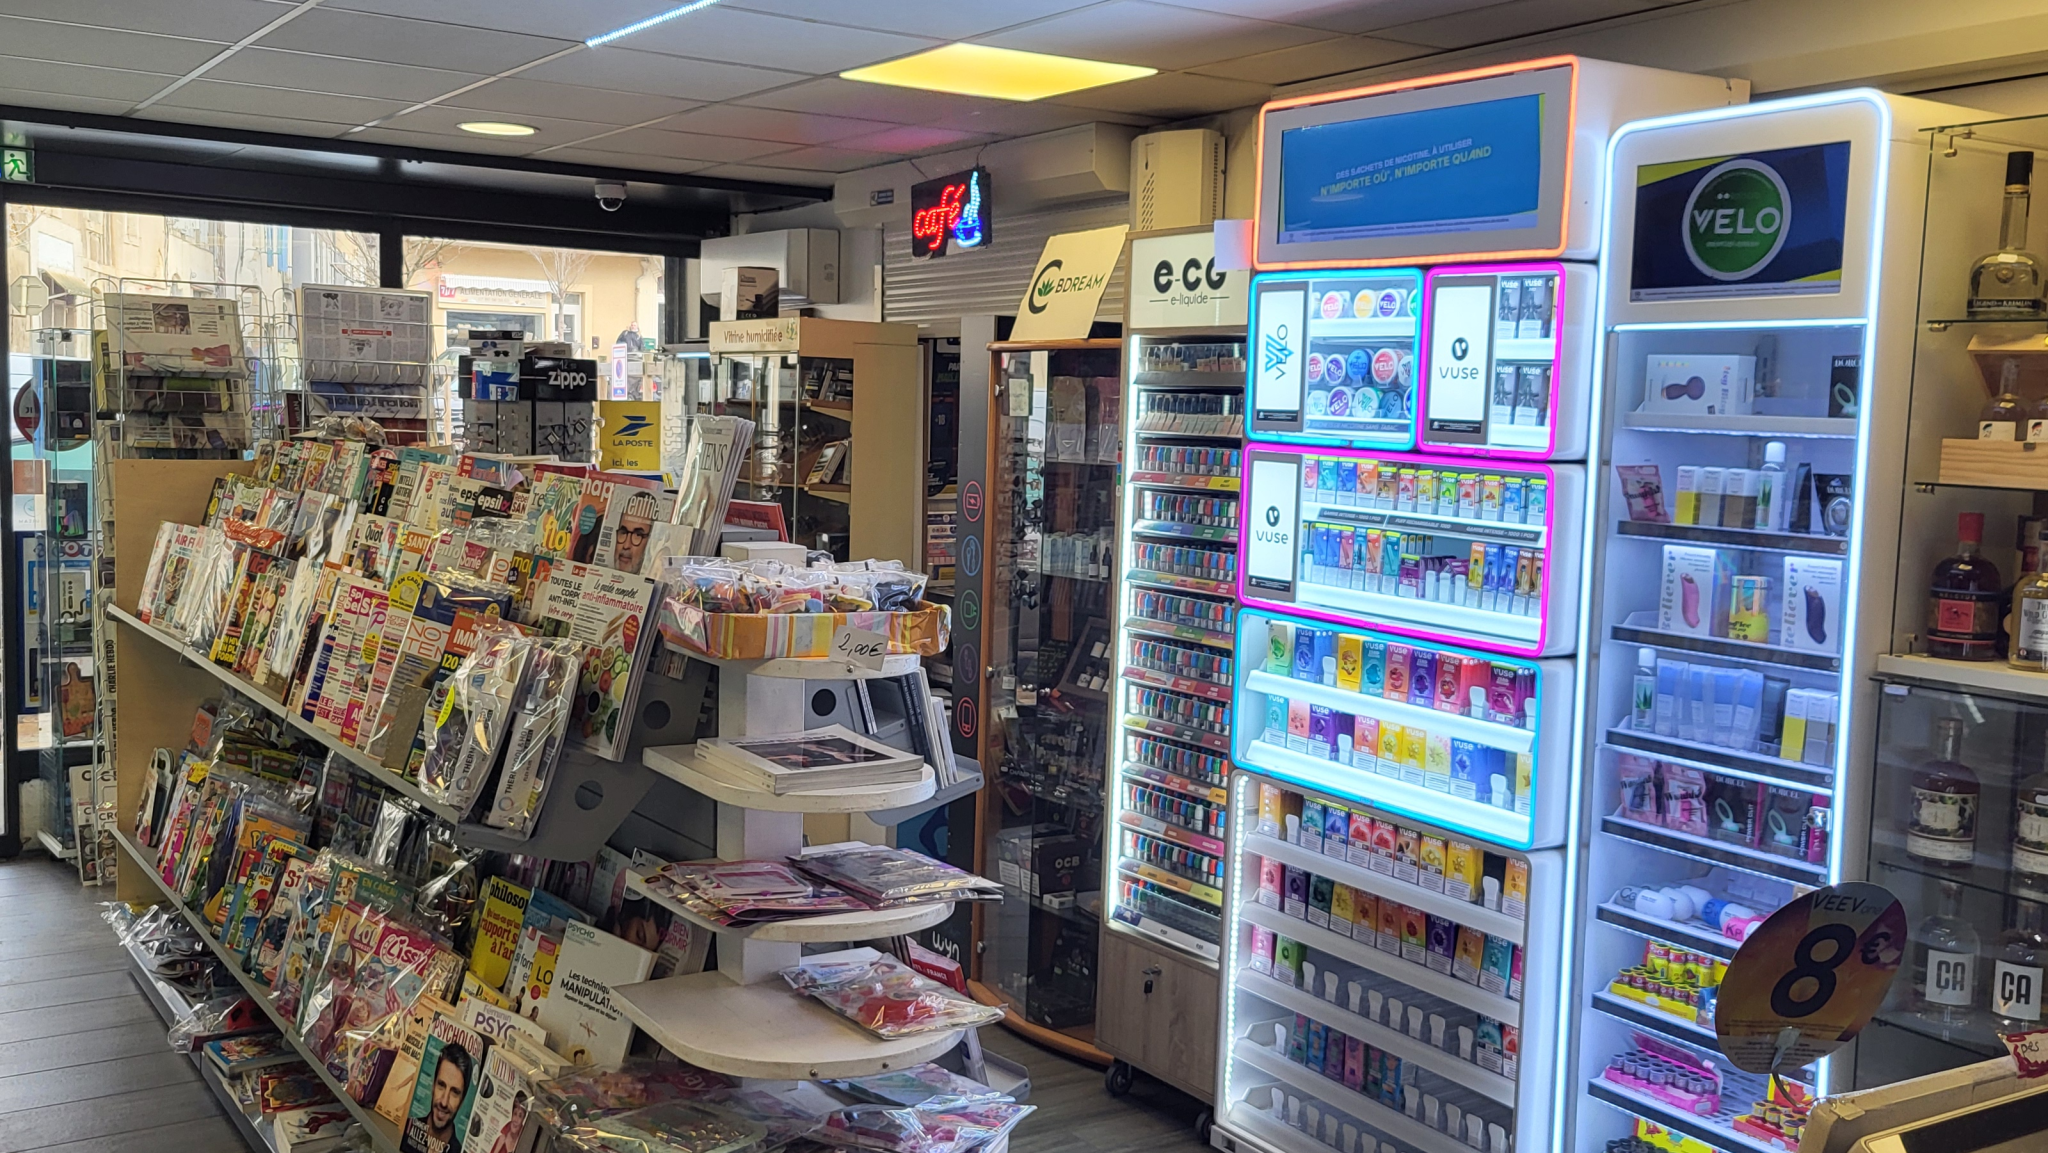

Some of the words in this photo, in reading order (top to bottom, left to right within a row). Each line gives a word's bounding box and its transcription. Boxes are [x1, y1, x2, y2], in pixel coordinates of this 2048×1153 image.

[1336, 170, 1349, 180] DES
[1351, 161, 1384, 176] SACHETS
[1384, 159, 1395, 168] DE
[1439, 138, 1473, 153] UTILISER
[1320, 176, 1371, 196] N'IMPORTE
[1394, 156, 1450, 178] N'IMPORTE
[1452, 145, 1492, 165] QUAND
[460, 289, 507, 298] ALIMENTATION
[1170, 291, 1209, 308] e-liquide
[723, 330, 745, 344] Vitrine
[746, 327, 783, 343] humidifiée
[548, 368, 587, 389] zippo
[612, 439, 624, 447] LA
[625, 440, 653, 448] POSTE
[627, 459, 639, 467] les
[550, 576, 573, 589] TOUTES
[581, 590, 644, 614] anti-inflammatoire
[615, 587, 640, 600] complet
[107, 639, 117, 664] HEBDO
[837, 632, 885, 660] 2,00€
[441, 653, 459, 671] 120
[108, 665, 117, 694] CHARLIE
[1055, 855, 1080, 869] OCB
[362, 877, 375, 889] EN
[1812, 891, 1868, 914] VEEV
[567, 922, 595, 939] PSYCHO
[672, 920, 690, 939] BIEN
[660, 927, 688, 952] DORMIR
[568, 969, 580, 982] Les
[926, 967, 948, 981] FRANCE
[1770, 922, 1858, 1019] 8
[483, 1002, 512, 1023] Féminin
[409, 1124, 446, 1153] ALLEZ-VOUS
